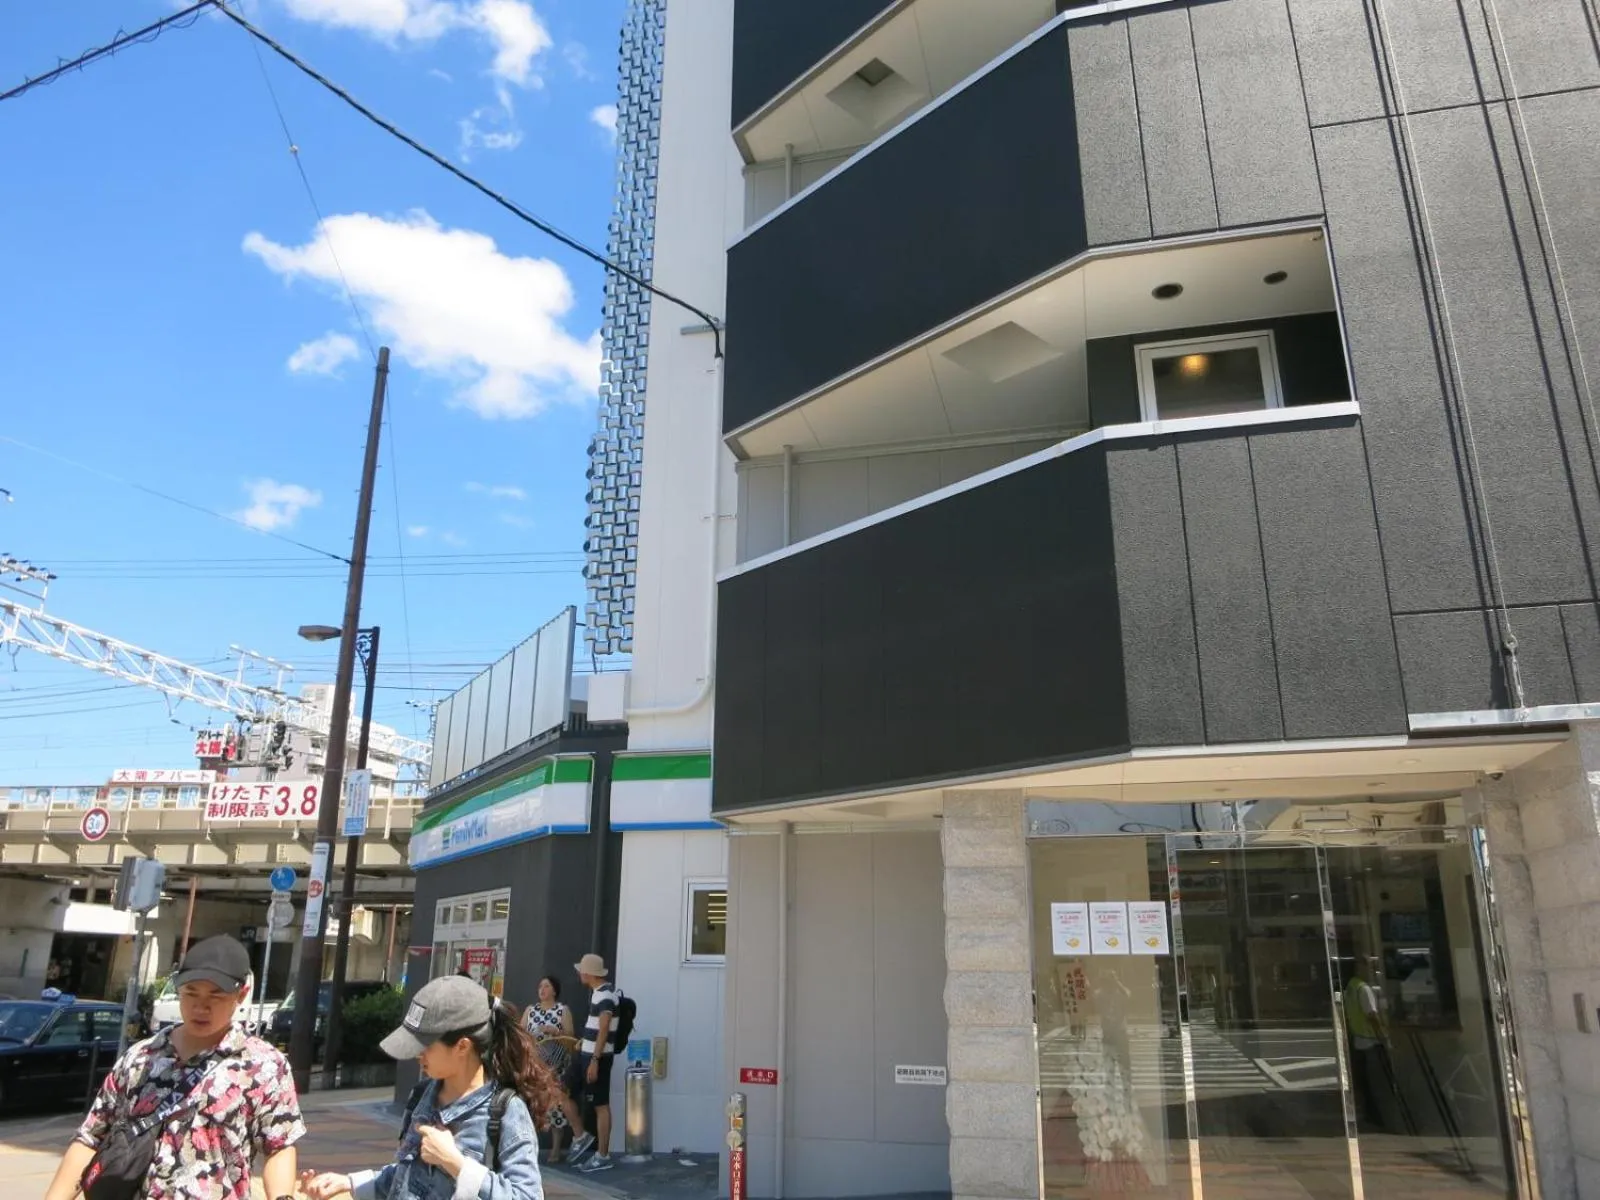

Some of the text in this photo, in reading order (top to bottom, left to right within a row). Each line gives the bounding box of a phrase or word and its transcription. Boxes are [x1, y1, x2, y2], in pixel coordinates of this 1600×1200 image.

[211, 784, 274, 801] けた下
[274, 785, 318, 816] 3.8
[207, 802, 271, 818] 制限高
